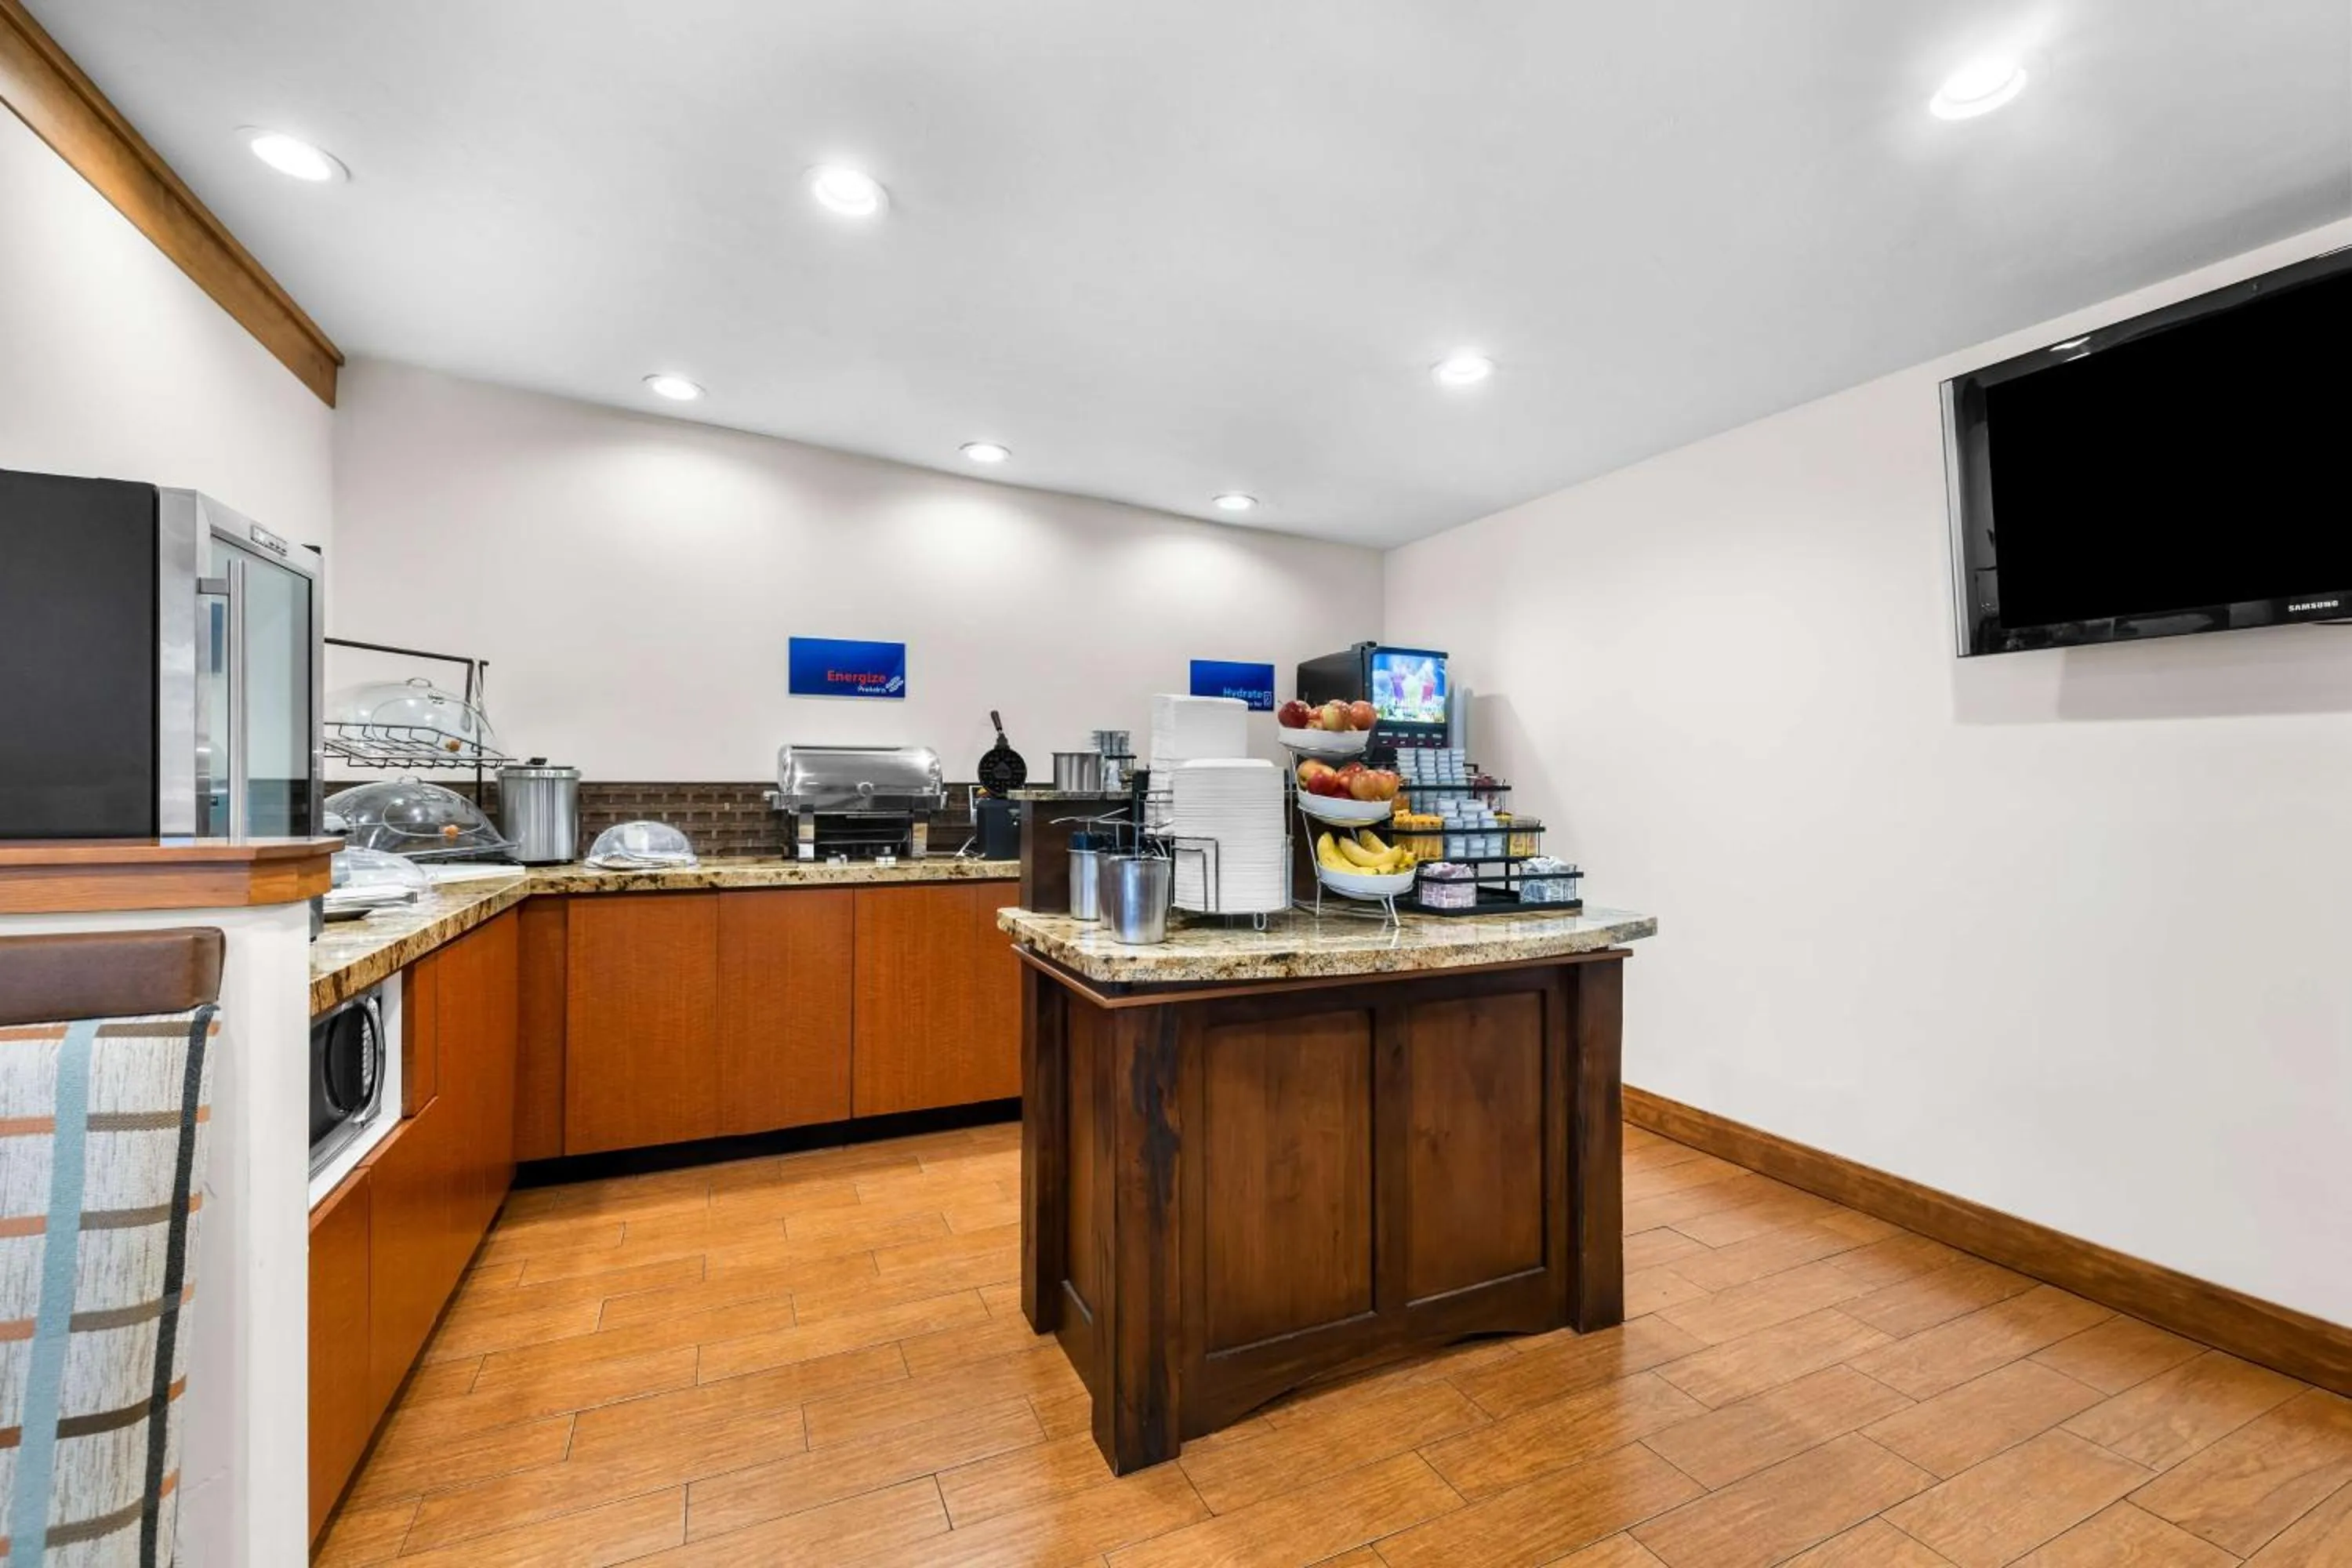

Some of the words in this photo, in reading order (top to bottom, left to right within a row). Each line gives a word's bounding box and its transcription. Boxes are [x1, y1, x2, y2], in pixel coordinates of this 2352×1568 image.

[2288, 600, 2339, 612] SAMSUNG
[827, 670, 887, 684] Energize
[1223, 687, 1263, 699] Hydrate
